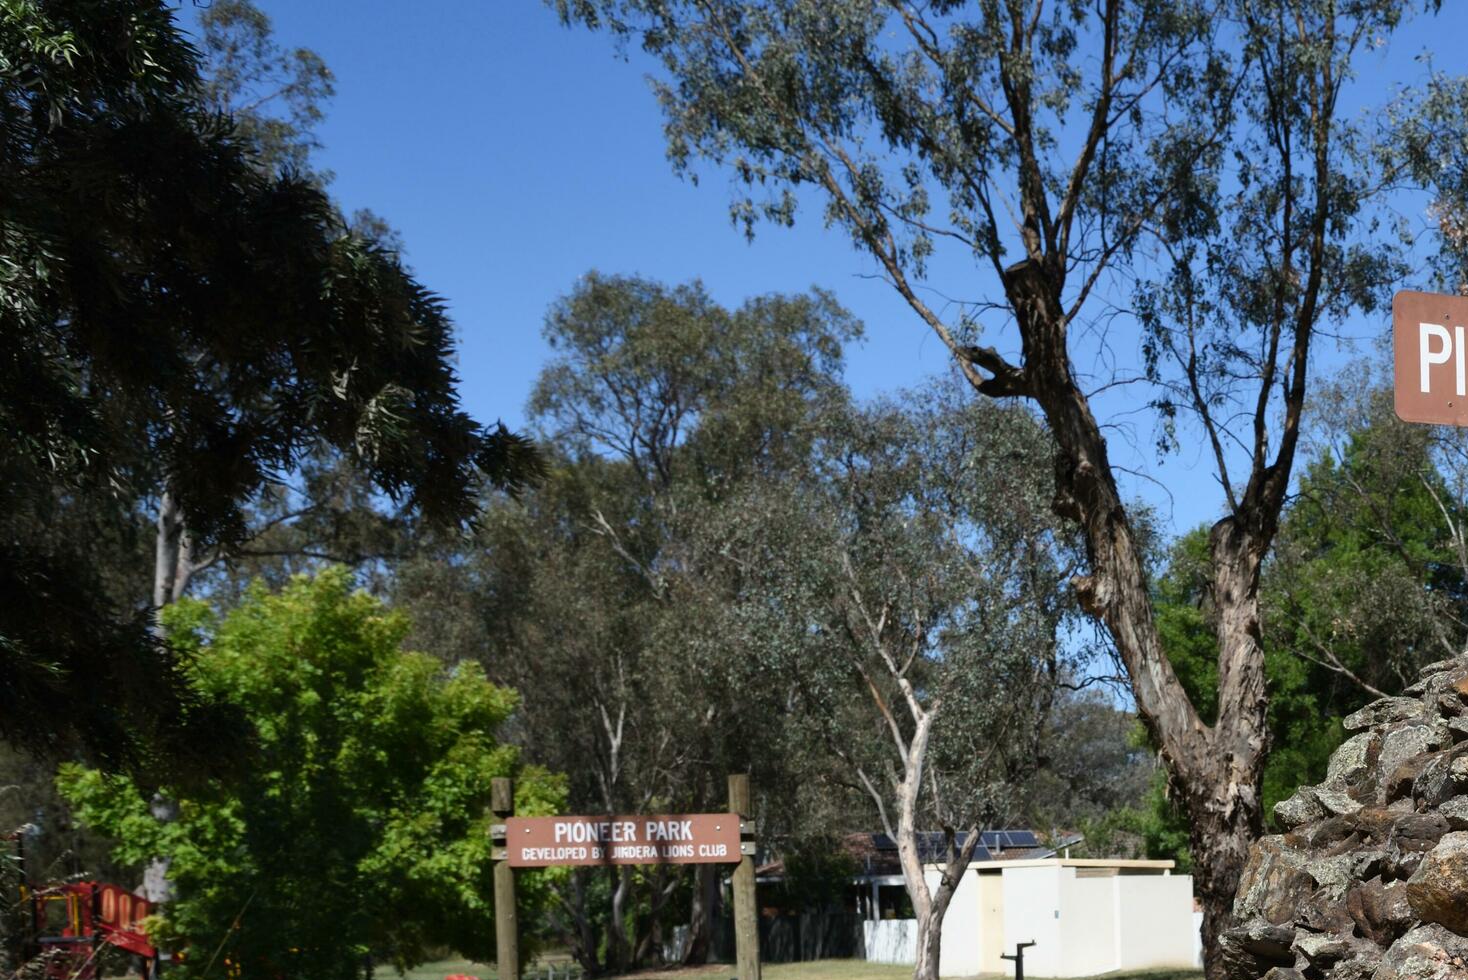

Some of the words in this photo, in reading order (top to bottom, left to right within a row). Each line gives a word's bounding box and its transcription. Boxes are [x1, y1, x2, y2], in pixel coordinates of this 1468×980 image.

[554, 820, 637, 843] PIONEER
[646, 820, 693, 841] PARK
[522, 847, 587, 860] DEVELOPED
[591, 846, 605, 858] BY
[611, 845, 657, 859] JINDERA
[663, 844, 694, 858] LIONS
[699, 842, 727, 857] CLUB
